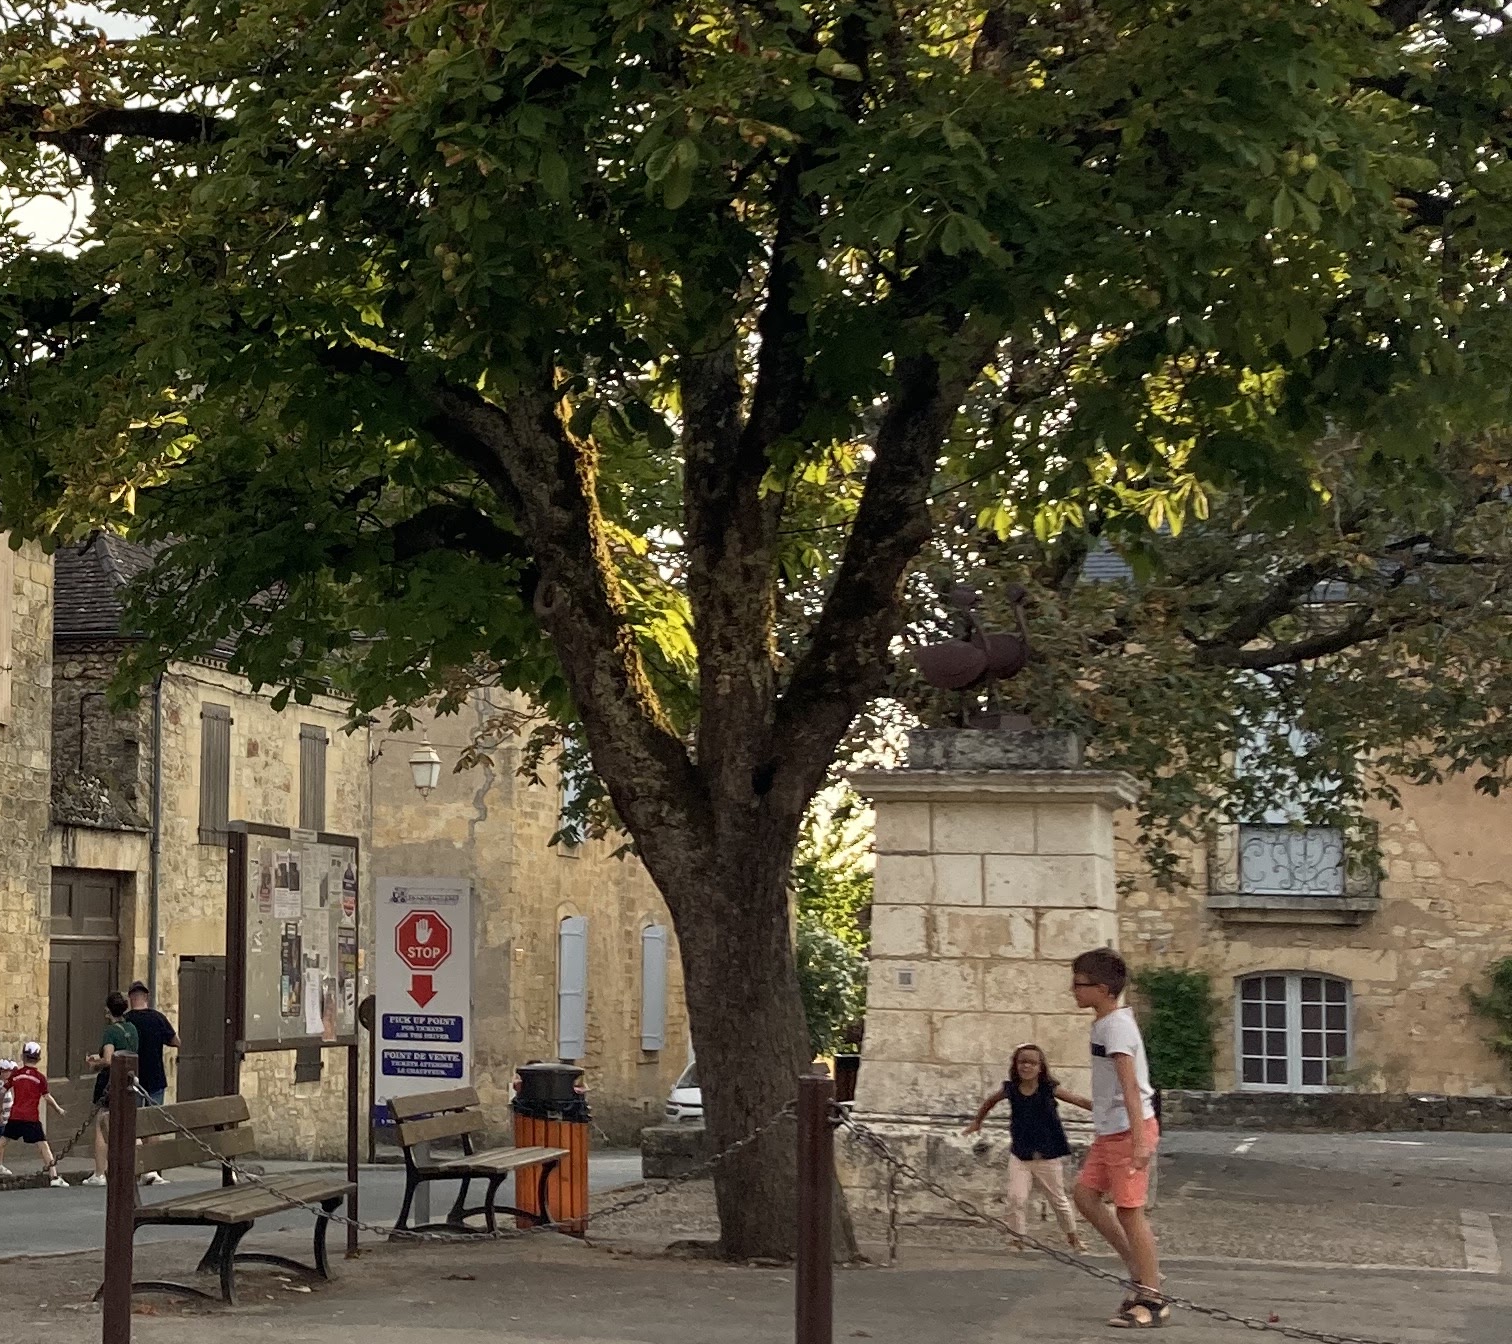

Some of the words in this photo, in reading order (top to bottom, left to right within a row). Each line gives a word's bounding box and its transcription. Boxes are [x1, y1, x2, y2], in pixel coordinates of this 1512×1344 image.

[407, 946, 441, 959] STOP
[389, 1016, 412, 1024] PICK
[413, 1017, 426, 1025] UP
[427, 1017, 456, 1026] POINT
[384, 1051, 412, 1061] POINT
[413, 1052, 427, 1061] DE
